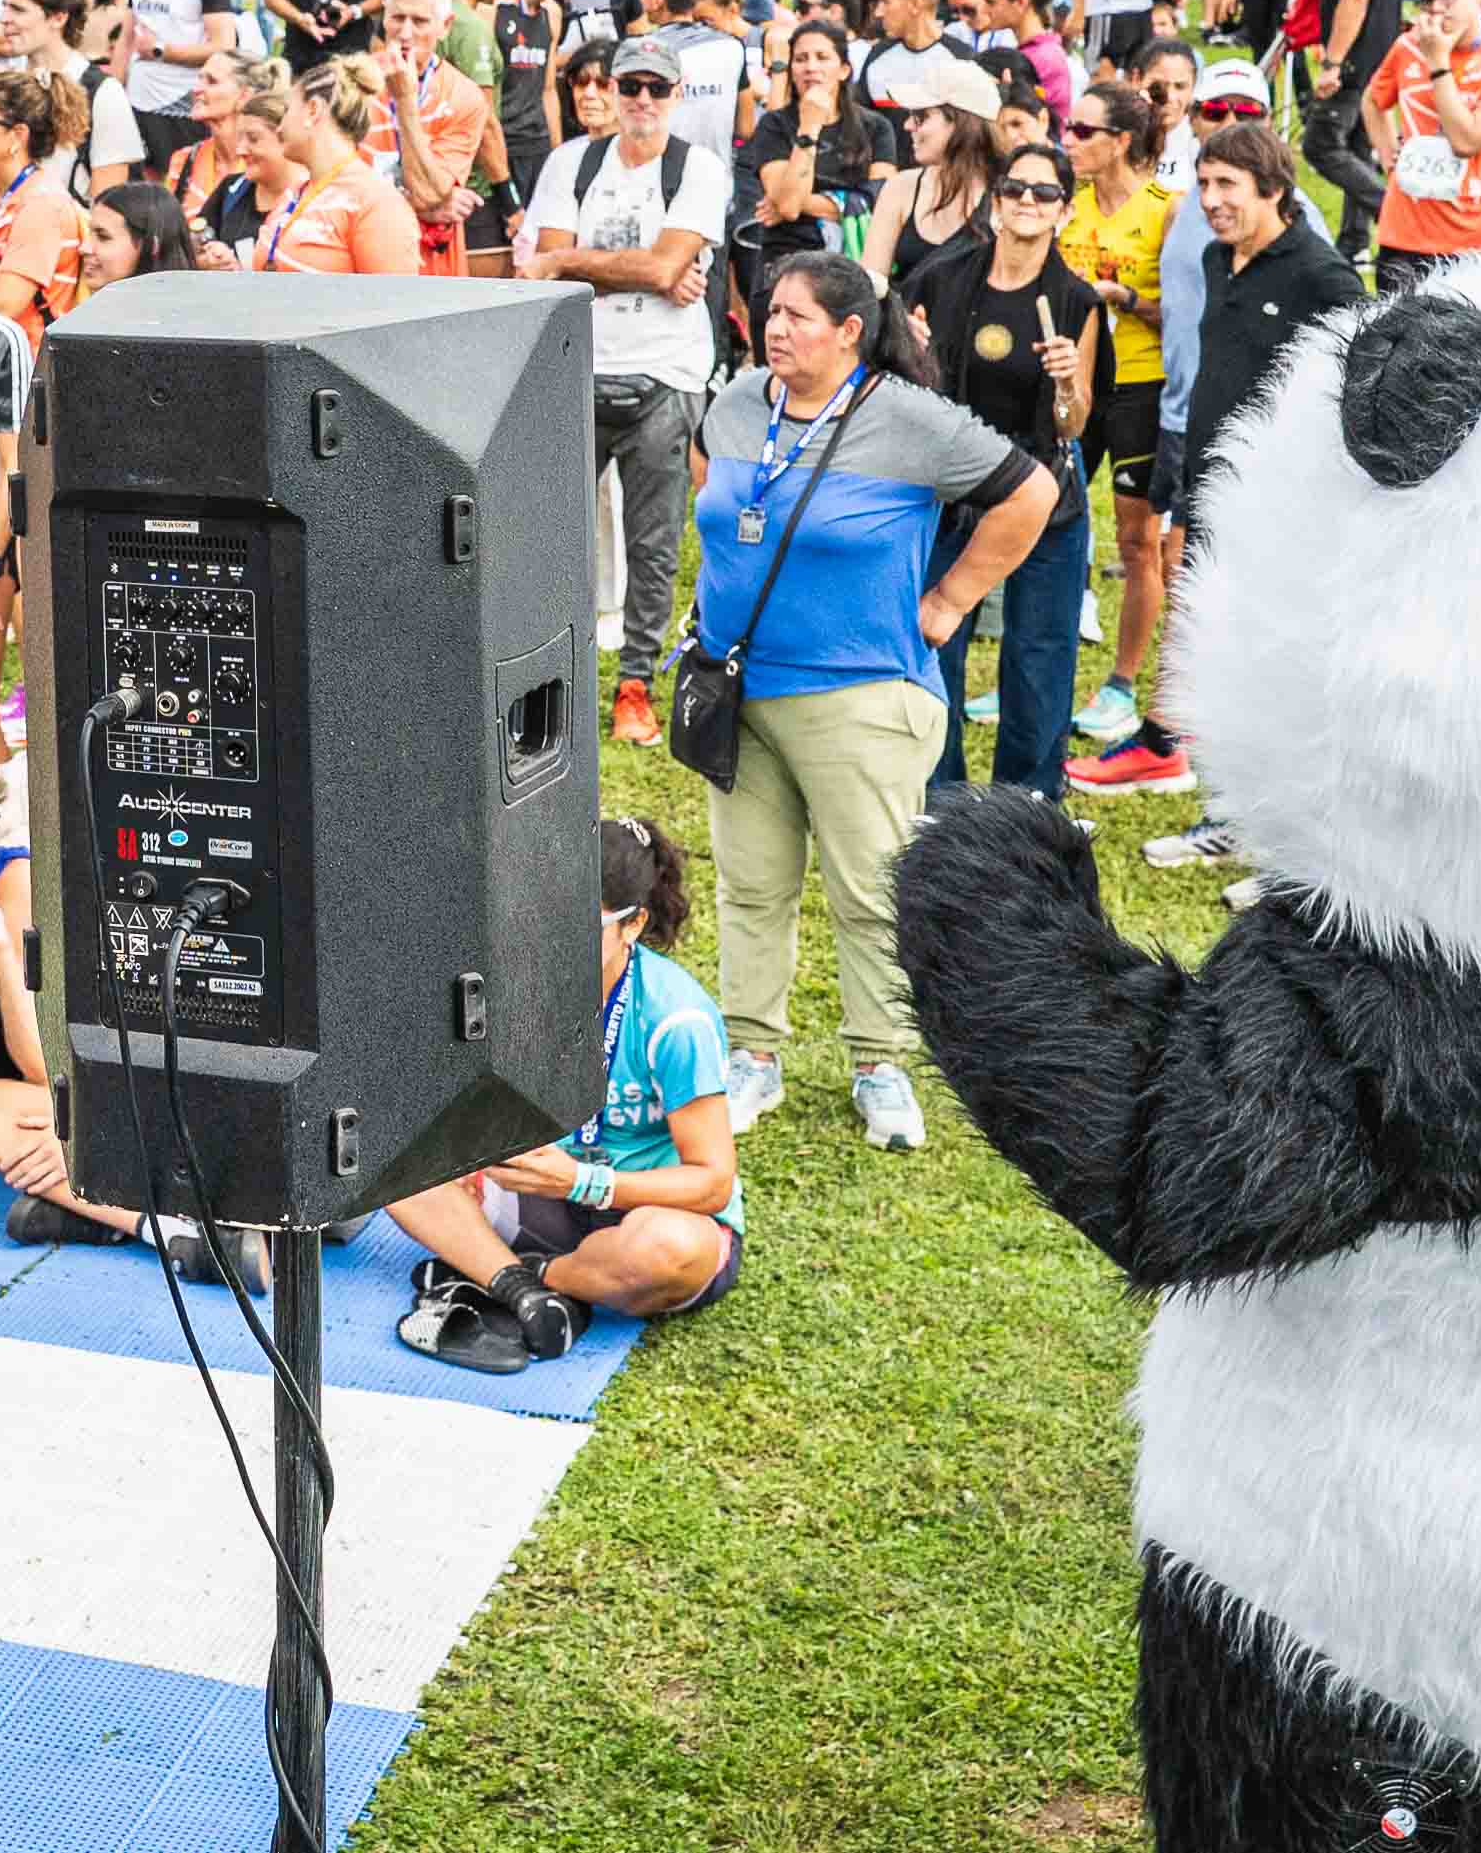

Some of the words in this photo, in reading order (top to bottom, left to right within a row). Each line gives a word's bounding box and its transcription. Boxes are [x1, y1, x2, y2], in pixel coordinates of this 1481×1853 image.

[125, 724, 142, 733] INPUT
[117, 827, 139, 861] SA
[141, 832, 161, 853] 312
[603, 1003, 625, 1054] PUERTO
